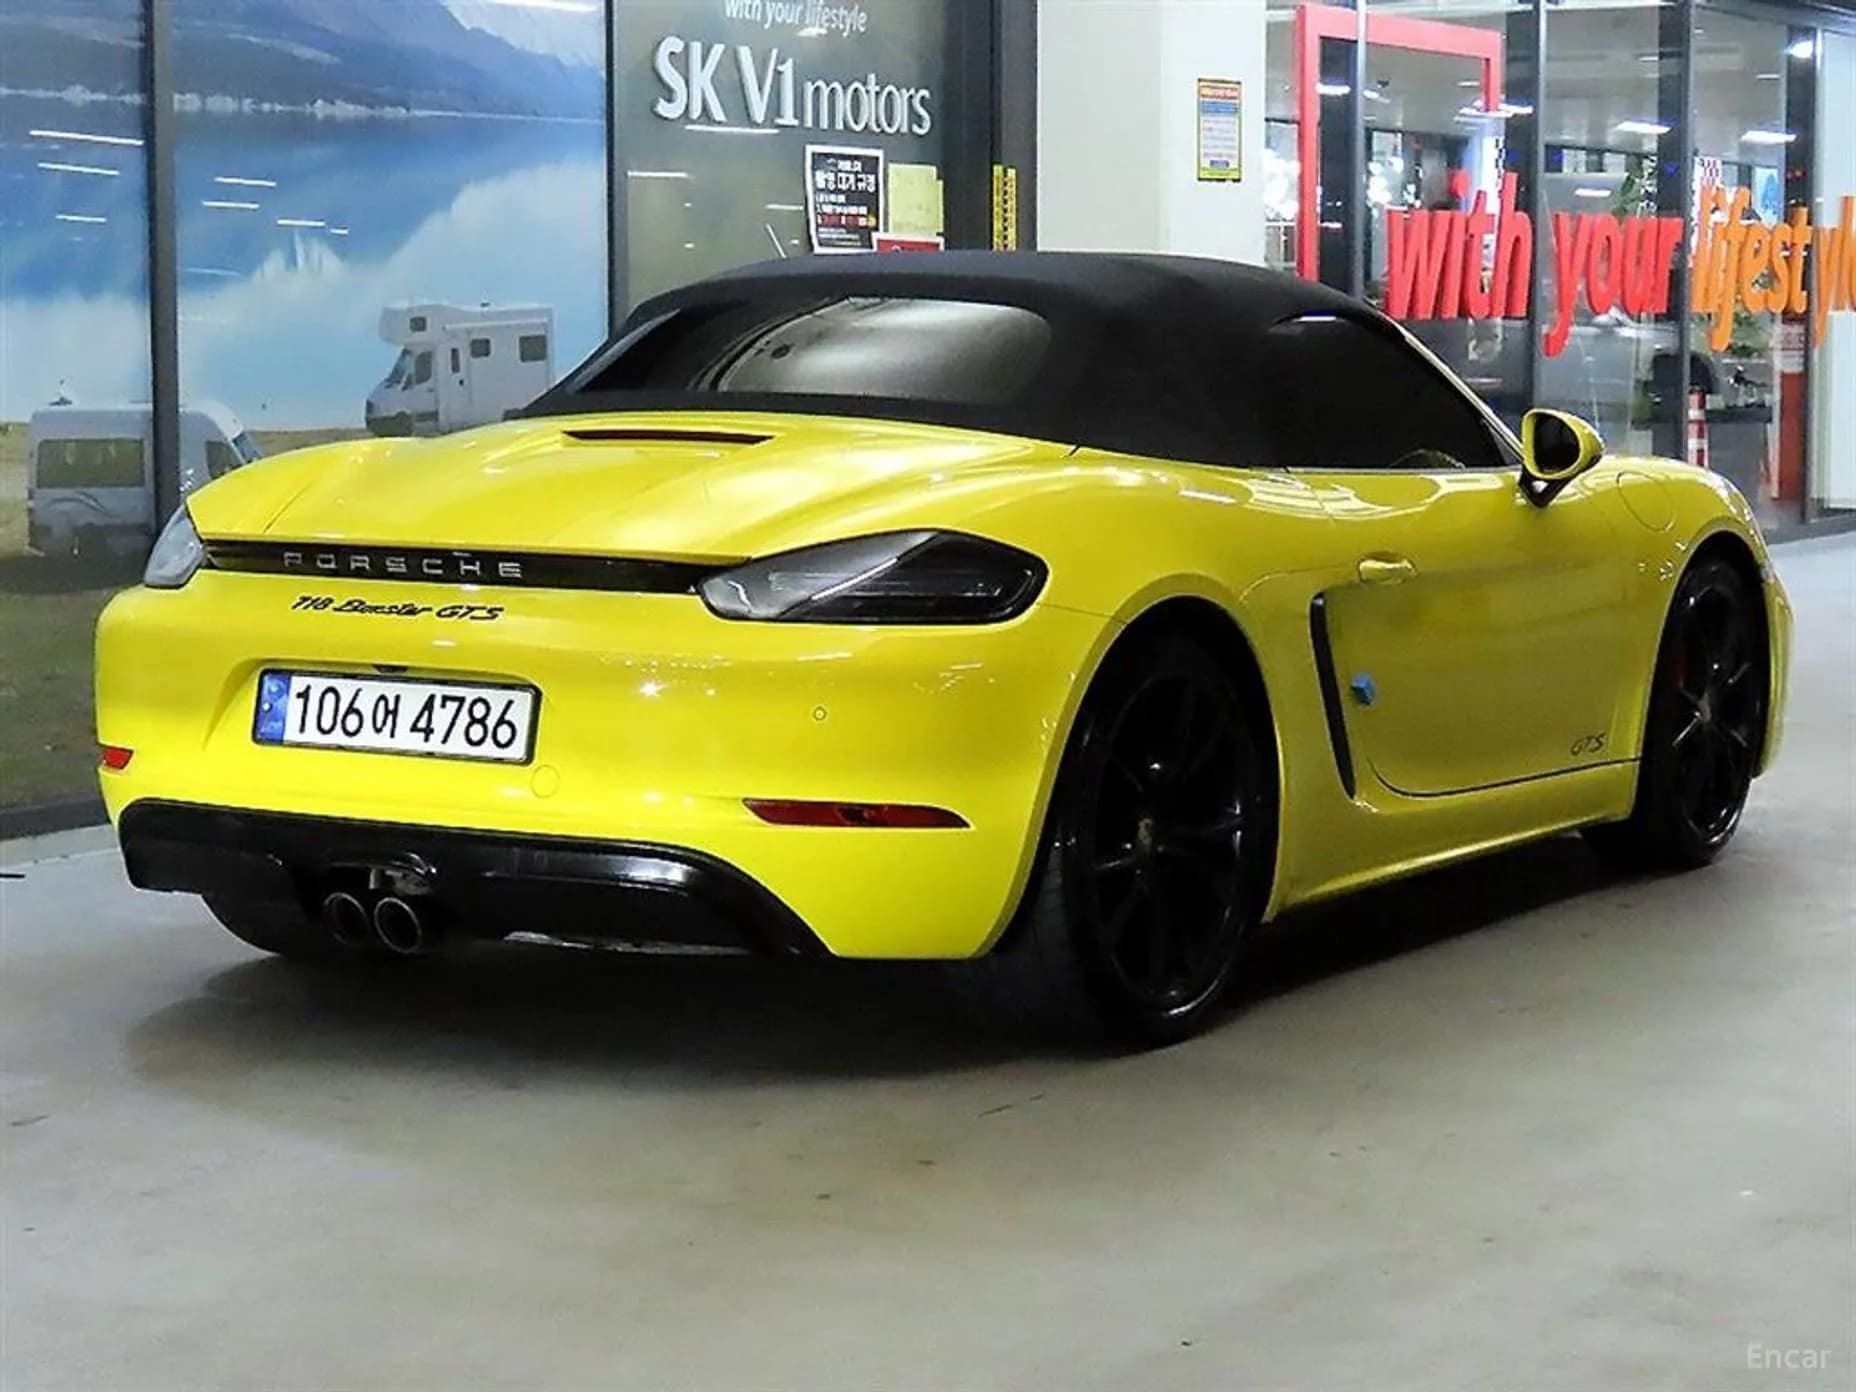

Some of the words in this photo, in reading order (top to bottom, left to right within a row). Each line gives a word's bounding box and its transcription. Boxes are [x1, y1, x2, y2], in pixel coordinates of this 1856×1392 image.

[725, 0, 761, 21] with
[764, 2, 803, 30] your
[804, 0, 868, 37] lifestyle
[653, 35, 727, 123] SK
[734, 45, 799, 127] V1
[802, 73, 933, 136] motors
[1385, 169, 1533, 320] with
[1541, 211, 1685, 358] your
[1689, 185, 1856, 351] lifestyl
[283, 551, 523, 578] PORSCHE
[292, 595, 334, 611] 718
[435, 604, 505, 621] GTS
[295, 684, 401, 739] 106어
[410, 693, 518, 750] 4786
[1570, 732, 1606, 756] GTS
